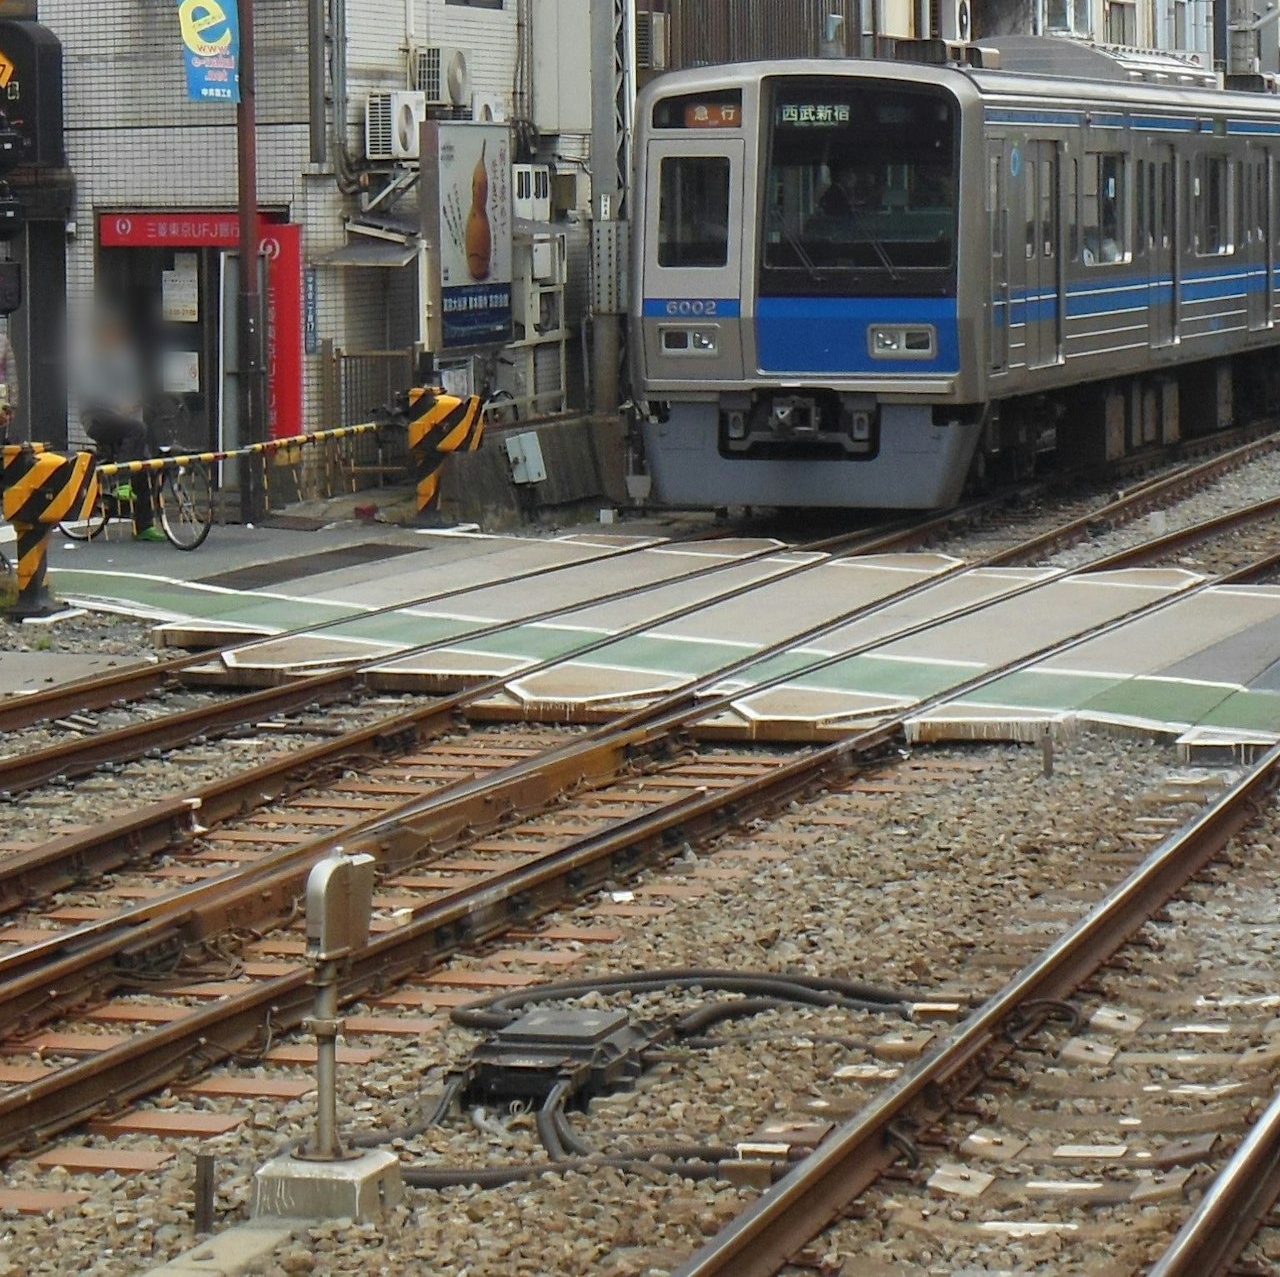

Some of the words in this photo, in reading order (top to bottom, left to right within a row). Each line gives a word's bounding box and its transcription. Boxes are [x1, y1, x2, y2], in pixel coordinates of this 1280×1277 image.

[694, 105, 736, 121] 急行
[782, 104, 851, 122] 西武新宿
[666, 300, 717, 315] 6002
